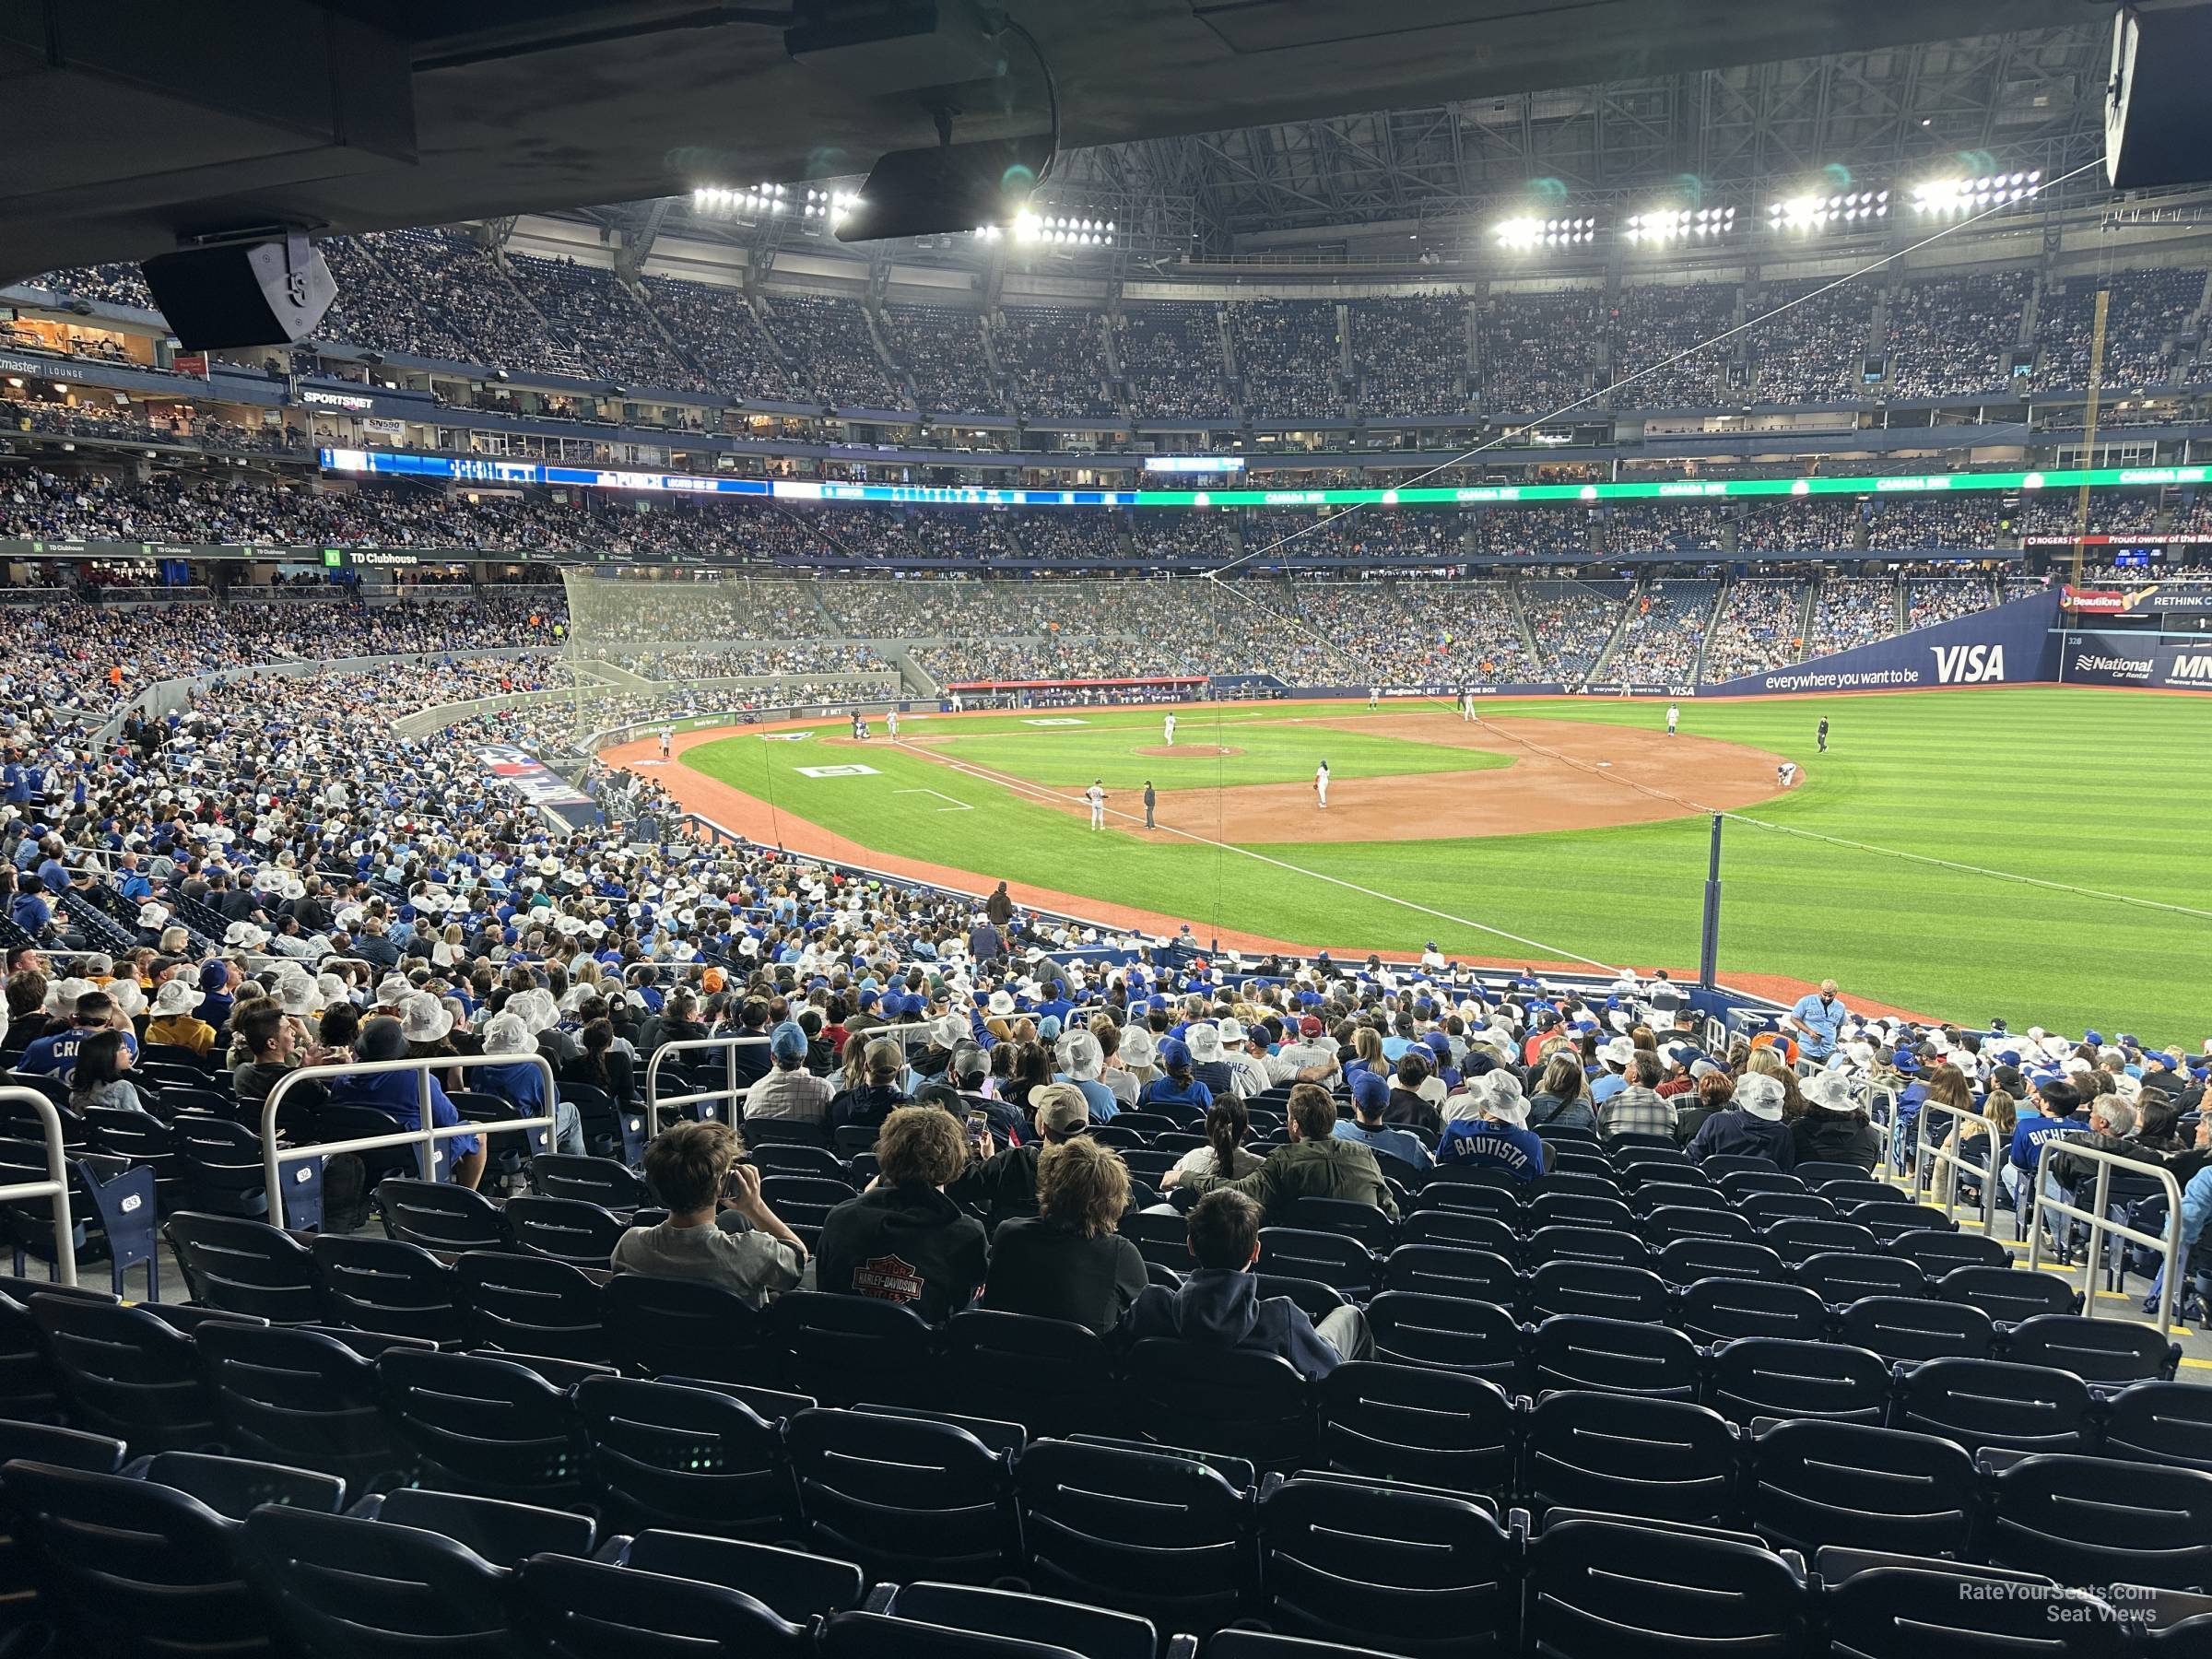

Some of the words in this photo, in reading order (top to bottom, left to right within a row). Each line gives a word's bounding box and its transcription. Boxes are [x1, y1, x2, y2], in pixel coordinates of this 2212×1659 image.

[49, 367, 84, 379] LOUNGE
[303, 392, 372, 408] SPORTSNET
[2108, 535, 2136, 544] Proud
[2168, 534, 2180, 544] of
[2181, 534, 2196, 544] the
[350, 553, 364, 563] TD
[366, 553, 418, 564] Clubhouse
[2154, 596, 2203, 606] RETHINK
[2068, 637, 2082, 645] 328
[1930, 644, 2005, 683] VISA
[1766, 672, 1836, 689] everywhere
[1837, 674, 1859, 688] you
[1860, 670, 1889, 685] want
[1890, 669, 1903, 683] to
[1904, 668, 1918, 682] be
[1562, 684, 1589, 694] VA
[1666, 686, 1695, 696] VISA
[1453, 1135, 1529, 1170] BAUTISTA
[299, 1170, 310, 1180] 32
[126, 1198, 137, 1208] 33
[858, 1272, 918, 1293] HARLEY-DAVIDSON
